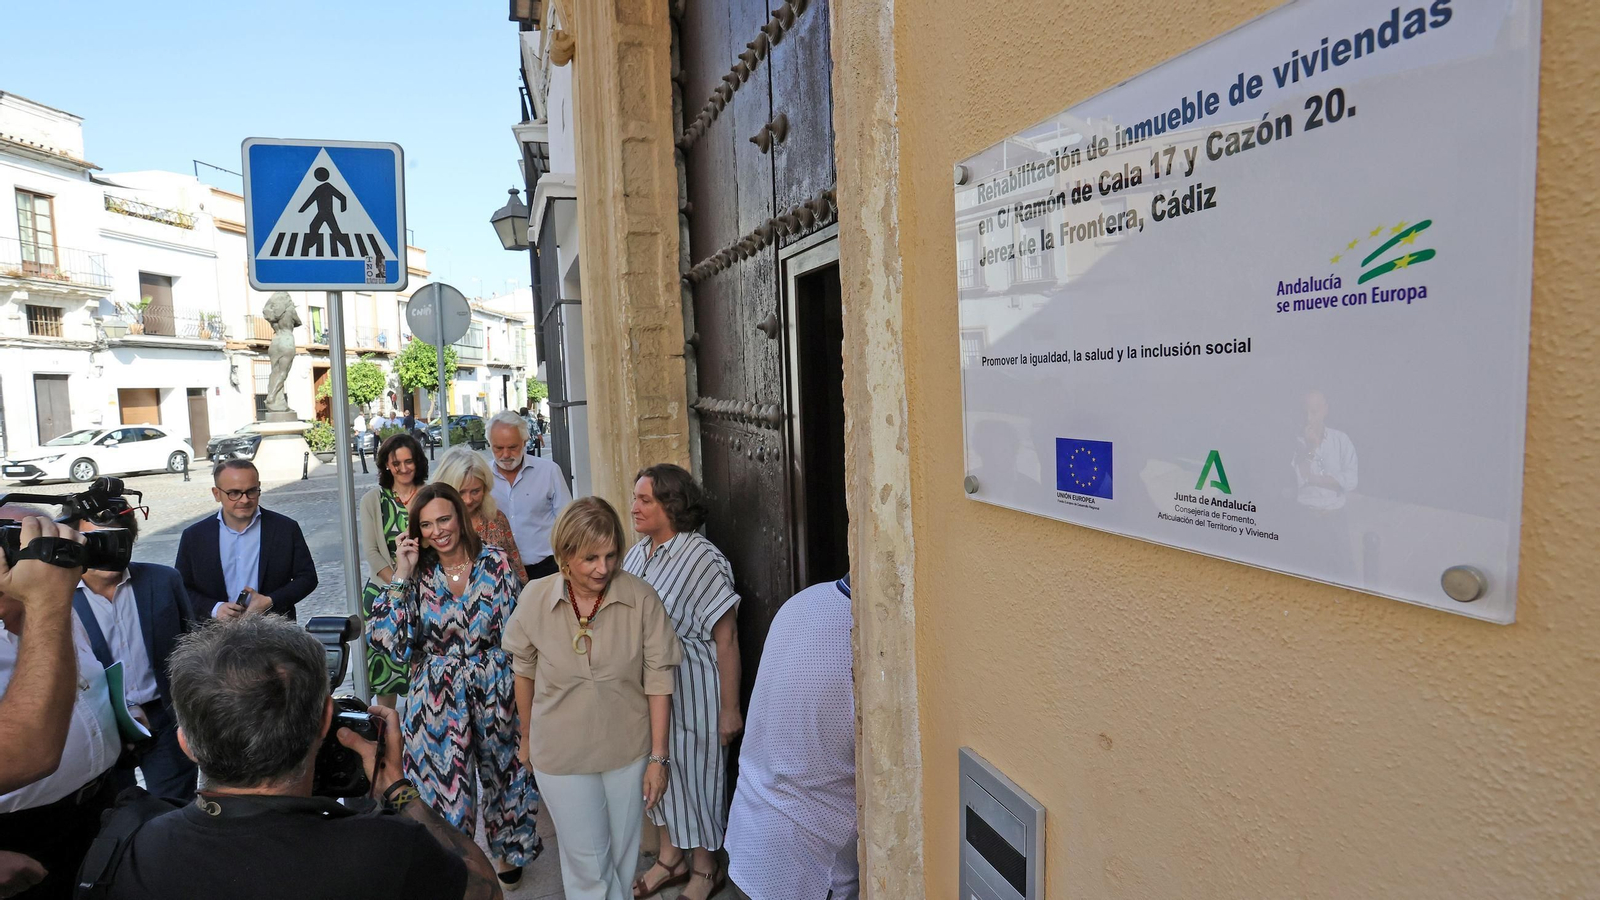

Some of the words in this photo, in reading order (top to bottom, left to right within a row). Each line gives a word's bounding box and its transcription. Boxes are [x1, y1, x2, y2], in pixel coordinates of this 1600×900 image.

[977, 146, 1081, 204] Rehabilitación
[1086, 135, 1109, 161] de
[1115, 90, 1220, 151] inmueble
[1228, 72, 1263, 107] de
[1272, 0, 1453, 89] viviendas
[978, 217, 994, 235] en
[997, 204, 1010, 229] C/
[1014, 189, 1066, 224] Ramón
[1071, 180, 1093, 205] de
[1098, 163, 1143, 196] Cala
[1150, 146, 1177, 179] 17
[1183, 145, 1198, 177] y
[1206, 112, 1293, 161] Cazón
[1303, 87, 1356, 132] 20.
[979, 244, 1015, 267] Jerez
[1018, 235, 1036, 257] de
[1040, 228, 1055, 251] la
[1060, 208, 1144, 246] Frontera,
[1151, 183, 1217, 221] Cádiz
[1276, 273, 1342, 296] Andalucía
[1276, 300, 1290, 313] se
[1293, 295, 1338, 312] mueve
[1341, 290, 1367, 306] con
[1371, 285, 1427, 304] Europa
[981, 356, 1018, 367] Promover
[1020, 353, 1028, 365] la
[1029, 350, 1071, 367] igualdad,
[1073, 349, 1082, 362] la
[1084, 347, 1114, 361] salud
[1116, 349, 1124, 363] y
[1127, 346, 1137, 359] la
[1140, 341, 1201, 358] inclusión
[1205, 337, 1251, 355] social
[1056, 491, 1072, 500] UNIÓN
[1072, 494, 1096, 504] EUROPEA
[1173, 492, 1197, 504] Junta
[1198, 495, 1210, 506] de
[1210, 497, 1257, 513] Andalucía
[1157, 512, 1194, 525] Articulación
[1194, 517, 1206, 527] del
[1207, 520, 1238, 533] Territorio
[1238, 527, 1244, 536] y
[1245, 527, 1279, 541] Vivienda
[1211, 510, 1221, 519] de
[1222, 512, 1257, 526] Fomento,
